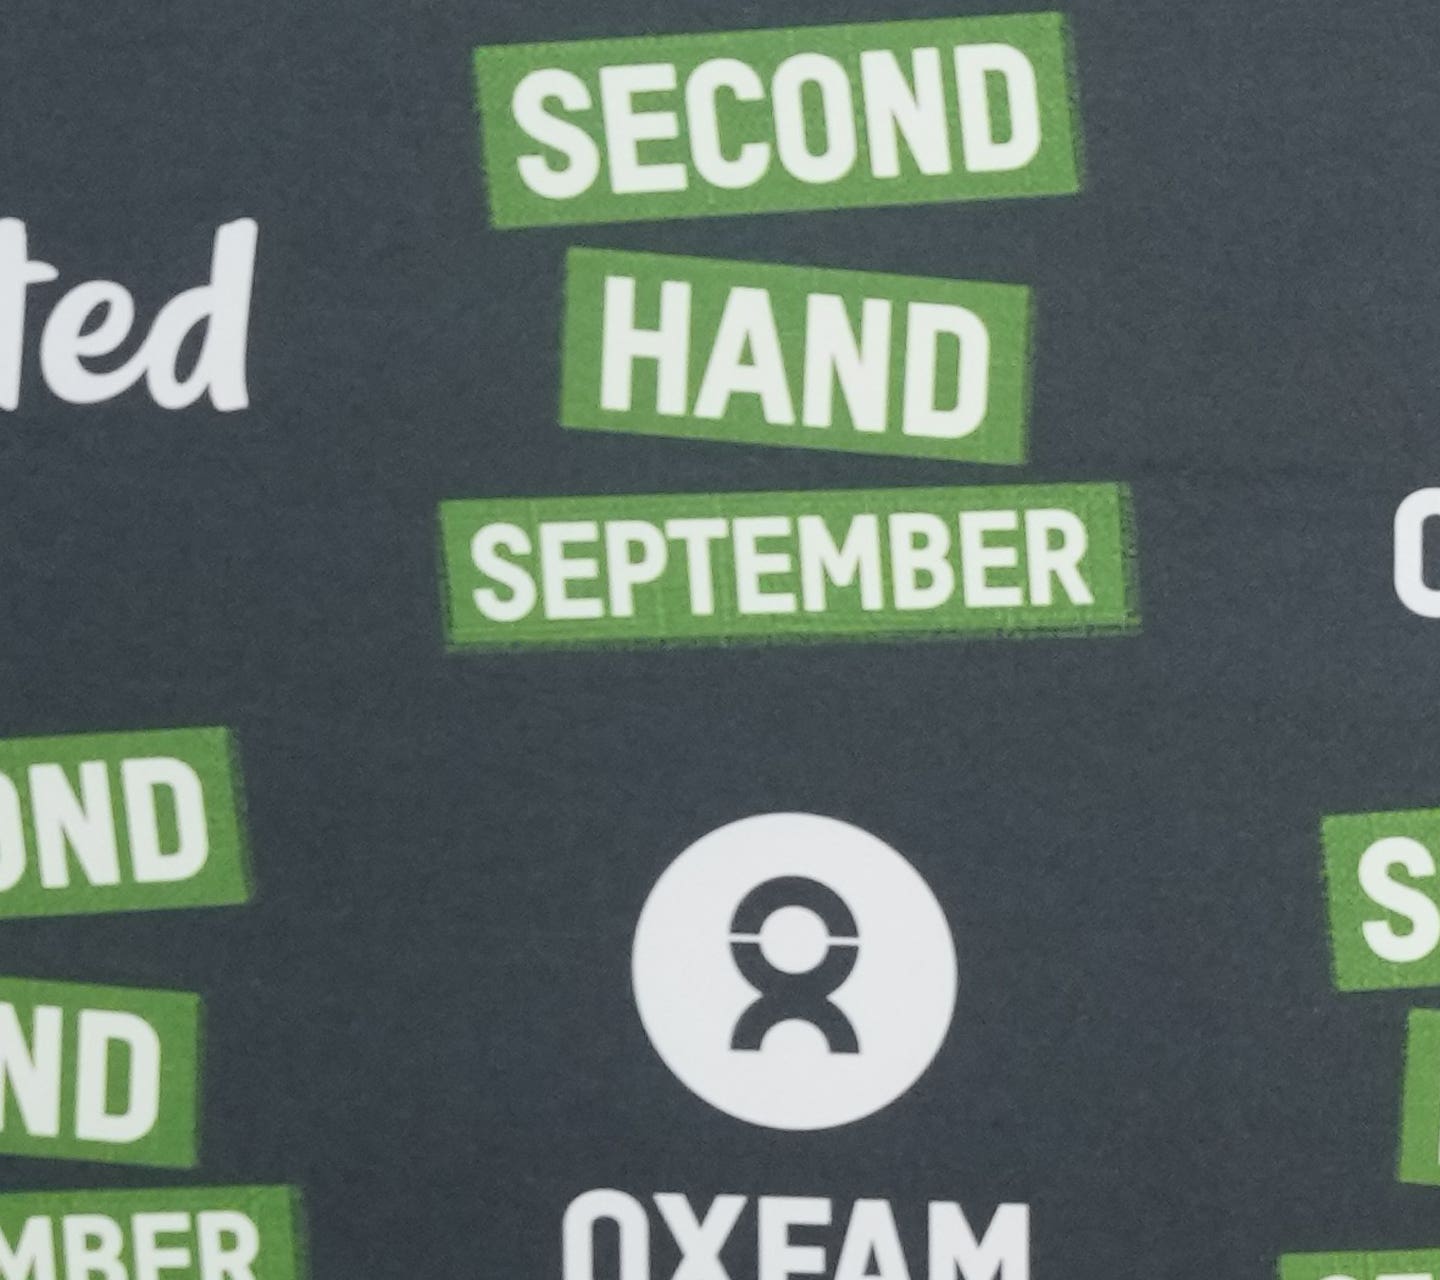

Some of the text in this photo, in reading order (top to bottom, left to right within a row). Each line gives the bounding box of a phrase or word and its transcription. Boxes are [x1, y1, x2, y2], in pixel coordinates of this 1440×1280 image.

[511, 43, 1041, 199] SECOND
[600, 275, 989, 439] HAND
[470, 508, 1093, 622] SEPTEMBER
